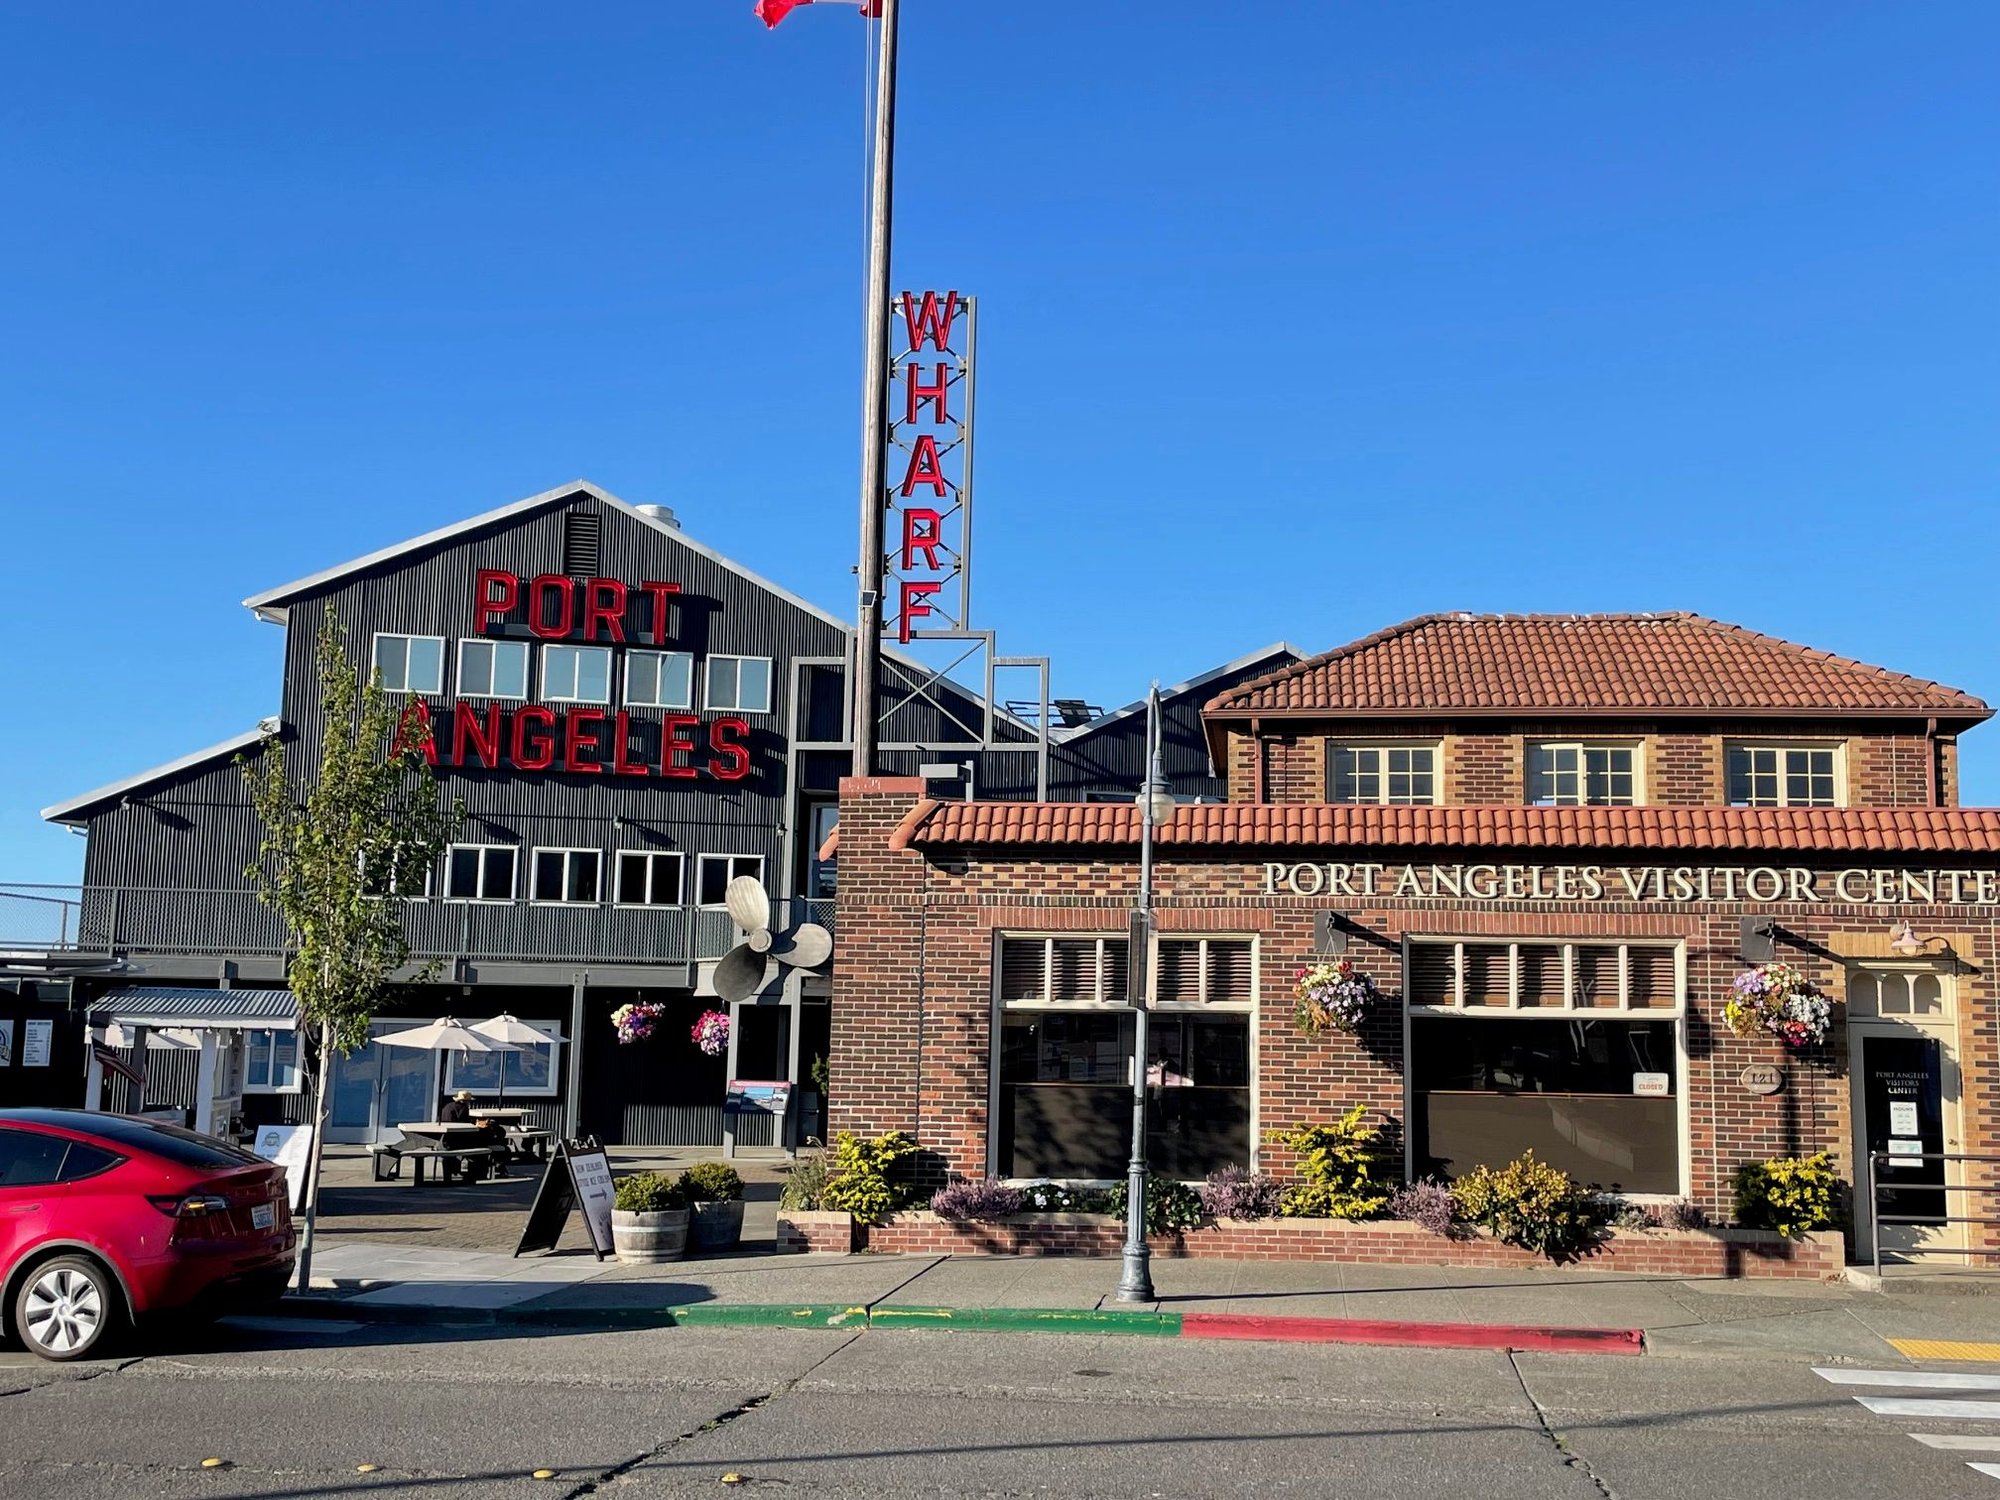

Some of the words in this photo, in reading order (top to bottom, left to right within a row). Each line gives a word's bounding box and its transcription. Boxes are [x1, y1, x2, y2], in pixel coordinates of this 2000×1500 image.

[899, 290, 958, 644] WHARF
[474, 568, 683, 646] PORT
[389, 697, 750, 782] ANGELES
[1262, 862, 1384, 897] PORT
[1393, 863, 1604, 900] ANGELES
[1616, 866, 1823, 902] VISITOR
[1836, 868, 1999, 905] CENTE
[1751, 1073, 1775, 1084] 121
[1875, 1071, 1895, 1079] PORT
[1896, 1072, 1930, 1080] ANGELES
[1886, 1079, 1920, 1087] VISITORS
[1887, 1087, 1918, 1095] CENTER
